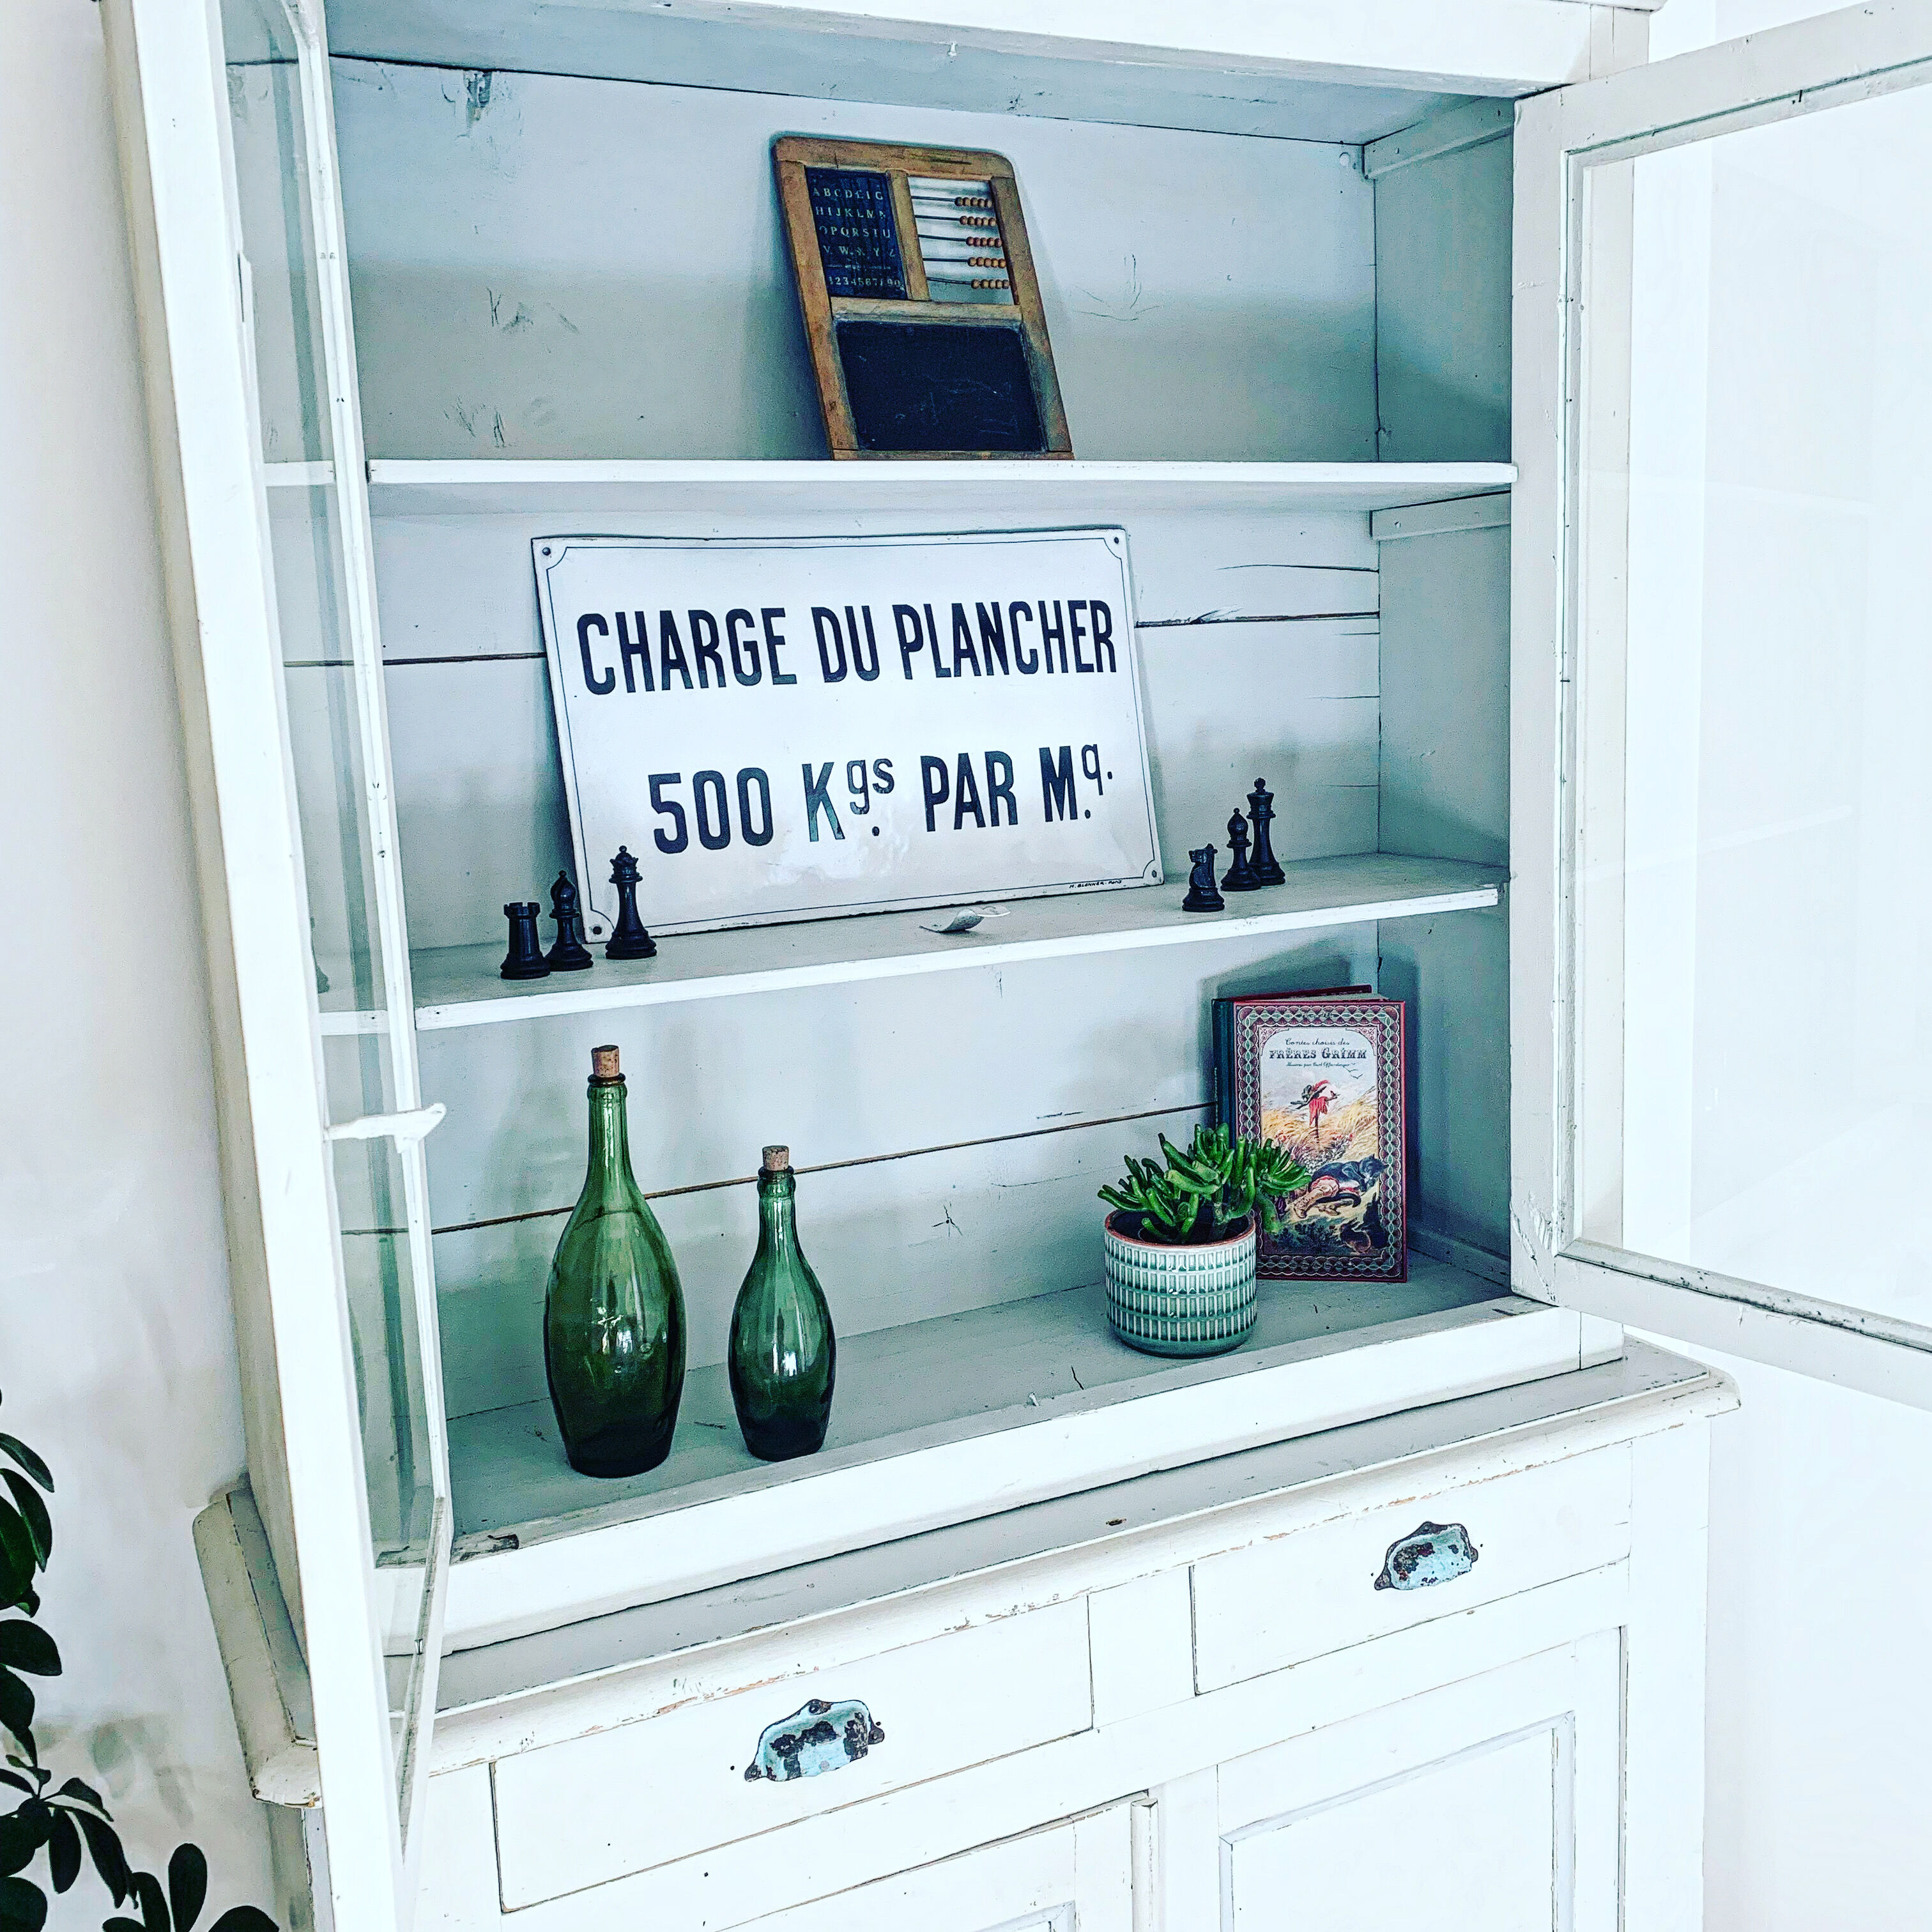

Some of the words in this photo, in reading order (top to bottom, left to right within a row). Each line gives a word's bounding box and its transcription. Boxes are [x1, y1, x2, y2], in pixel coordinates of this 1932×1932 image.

[577, 608, 797, 695] CHARGE
[811, 606, 879, 682] DU
[893, 600, 1117, 680] PLANCHER
[648, 767, 774, 854] 500
[920, 751, 1018, 832] PAR
[1269, 1047, 1316, 1059] FRÈRES
[1322, 1047, 1367, 1059] GRIMM
